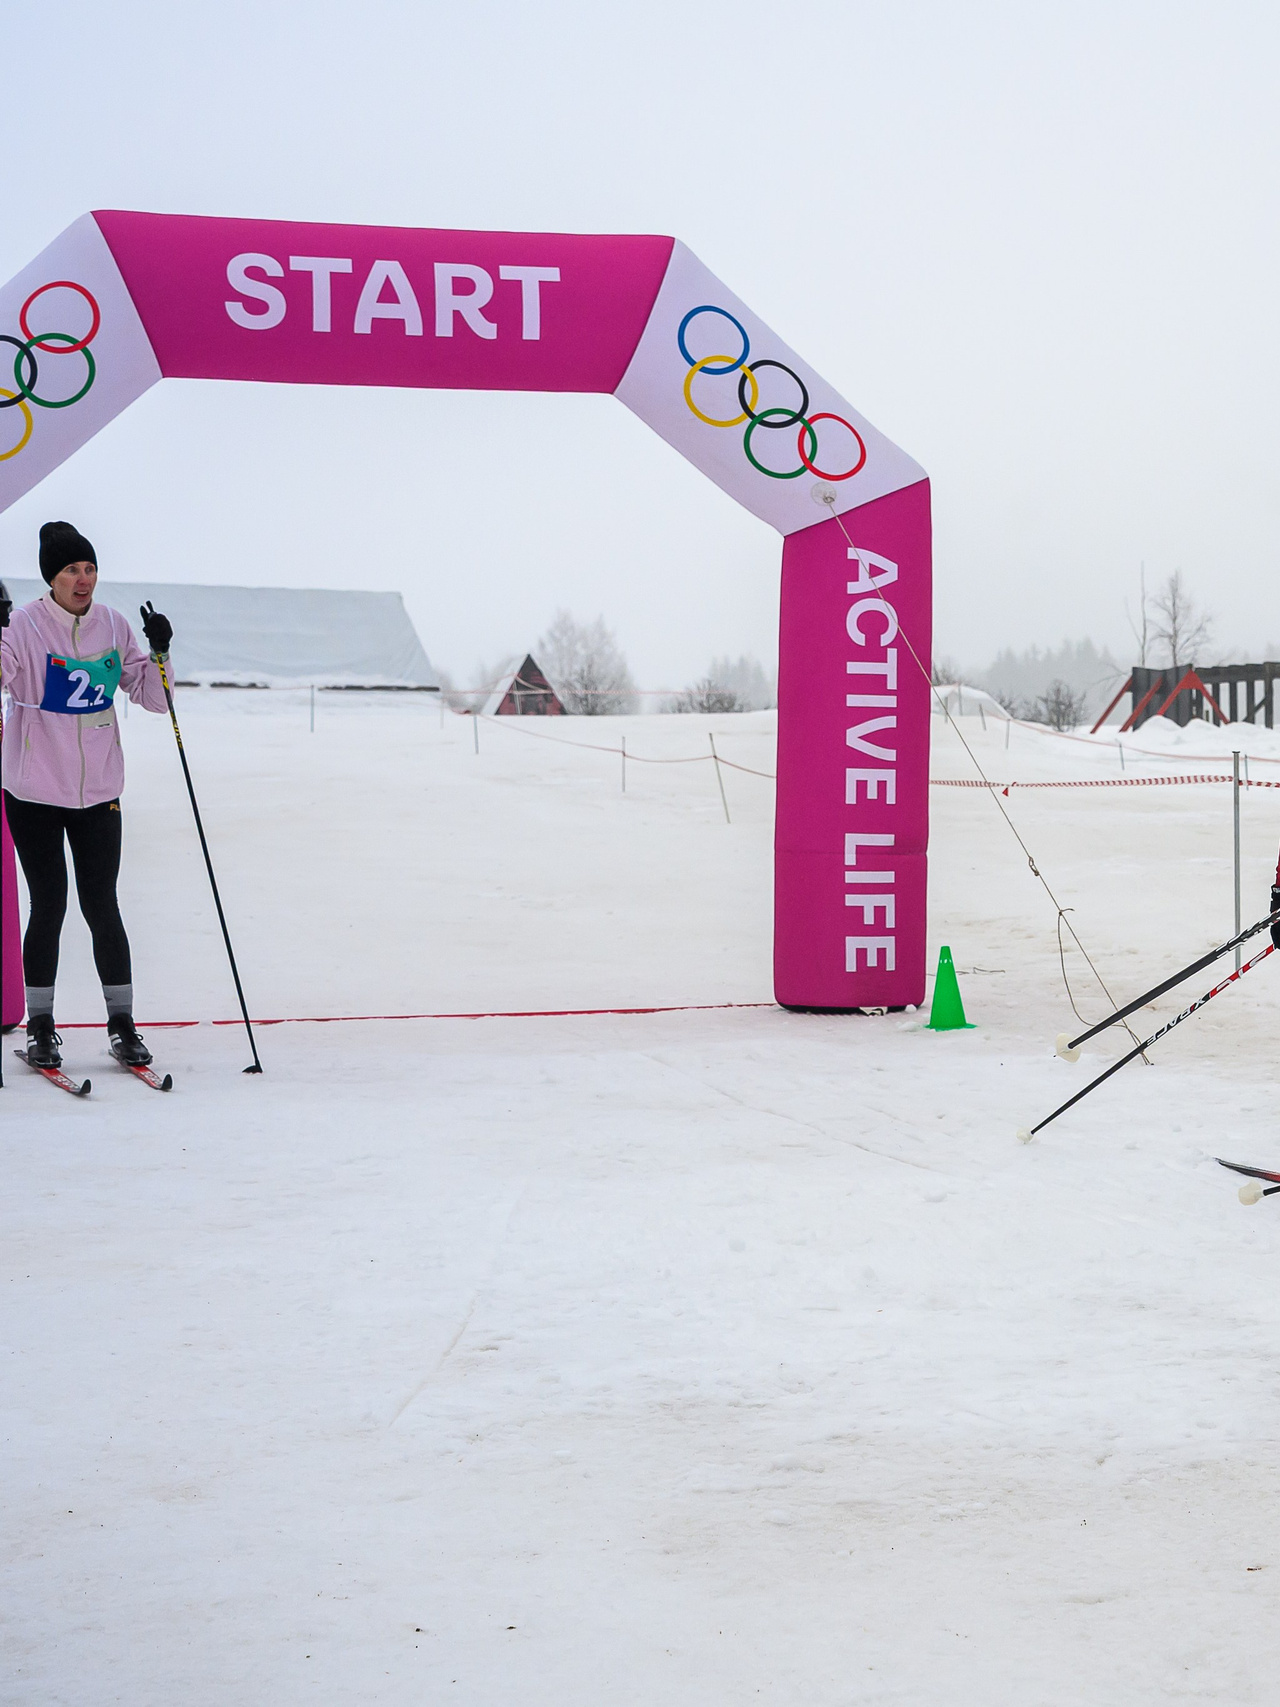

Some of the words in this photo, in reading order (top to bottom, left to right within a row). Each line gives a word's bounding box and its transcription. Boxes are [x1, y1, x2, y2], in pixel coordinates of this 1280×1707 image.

[224, 252, 561, 341] START
[66, 669, 105, 708] 2.2
[845, 547, 899, 805] ACTIVE
[844, 833, 896, 972] LIFE
